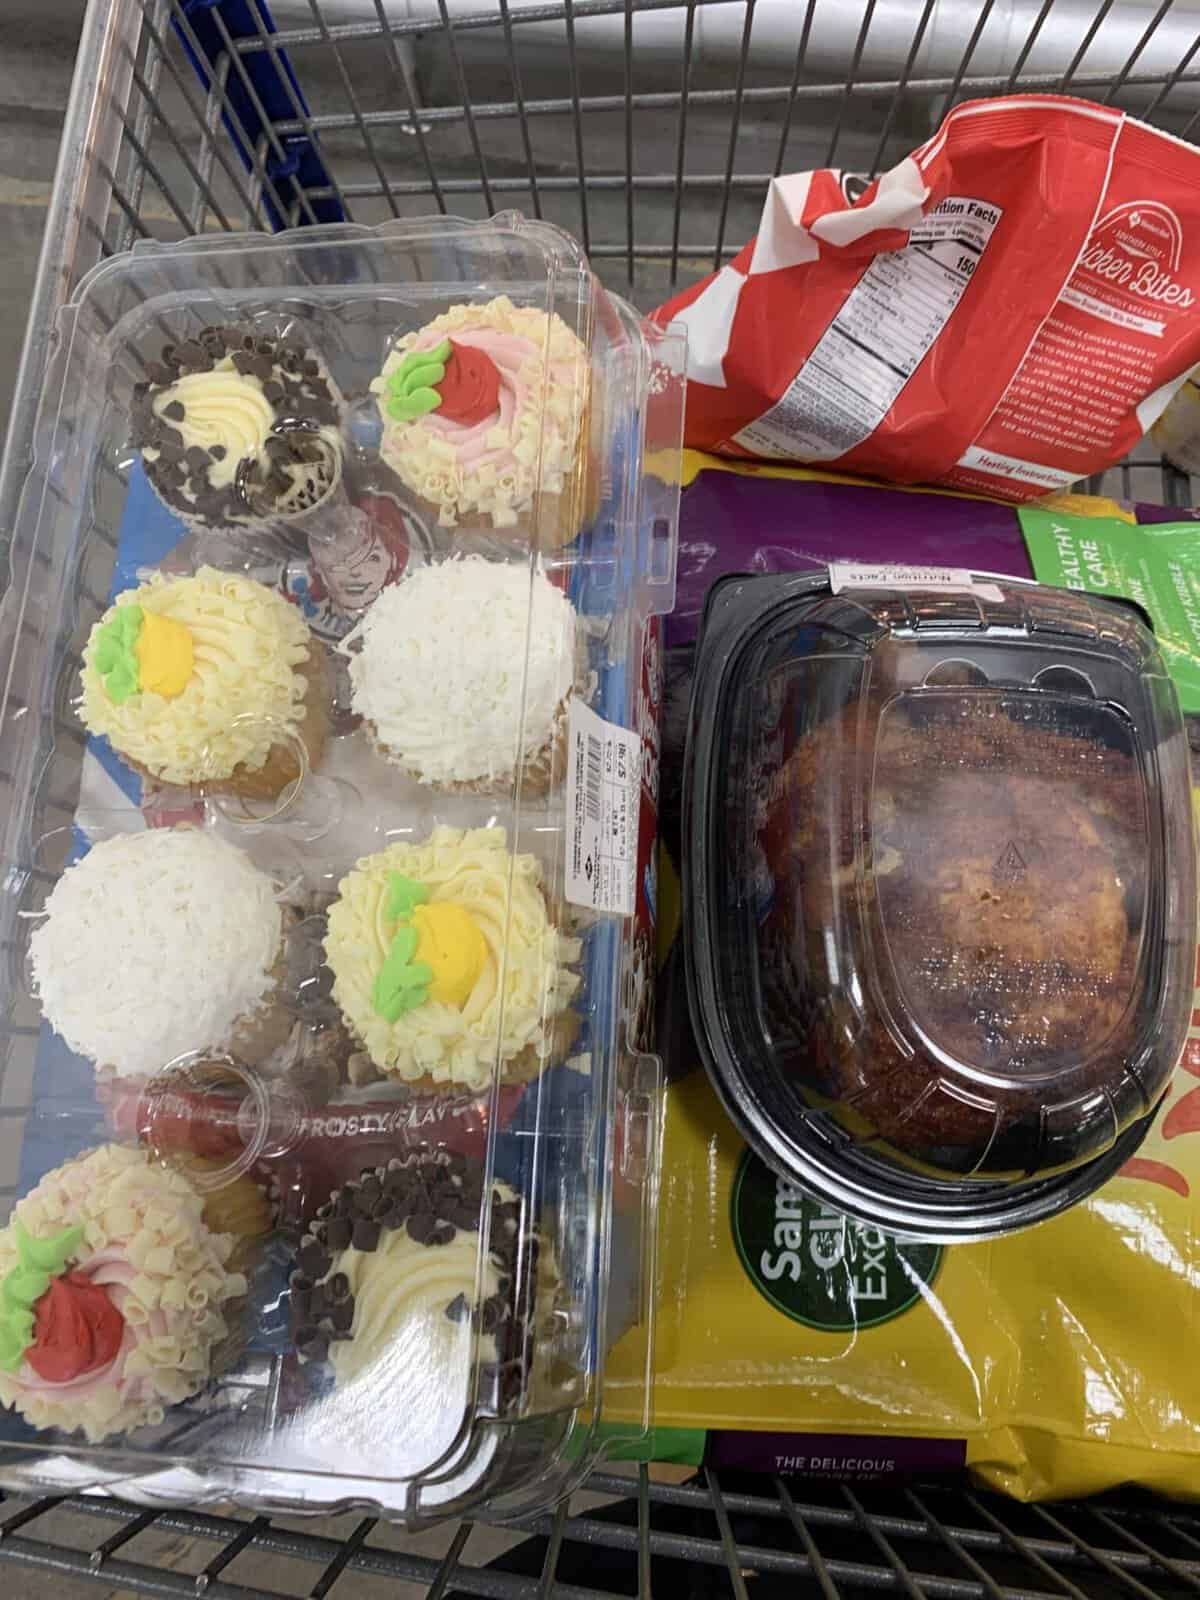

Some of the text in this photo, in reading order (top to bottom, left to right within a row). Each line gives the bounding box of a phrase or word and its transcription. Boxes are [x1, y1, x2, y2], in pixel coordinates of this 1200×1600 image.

[934, 200, 964, 214] rition
[967, 202, 998, 225] Facts
[957, 256, 976, 276] 150
[1129, 261, 1195, 307] Bites
[977, 455, 1015, 474] Heating
[1051, 523, 1085, 591] EALTHY
[1080, 539, 1108, 587] CARE
[849, 573, 951, 582] Nutrition Facts
[296, 1112, 390, 1137] FROSTY
[761, 1177, 802, 1282] Sam
[809, 1207, 842, 1271] Cl
[775, 1456, 895, 1471] THE DELICIOUS
